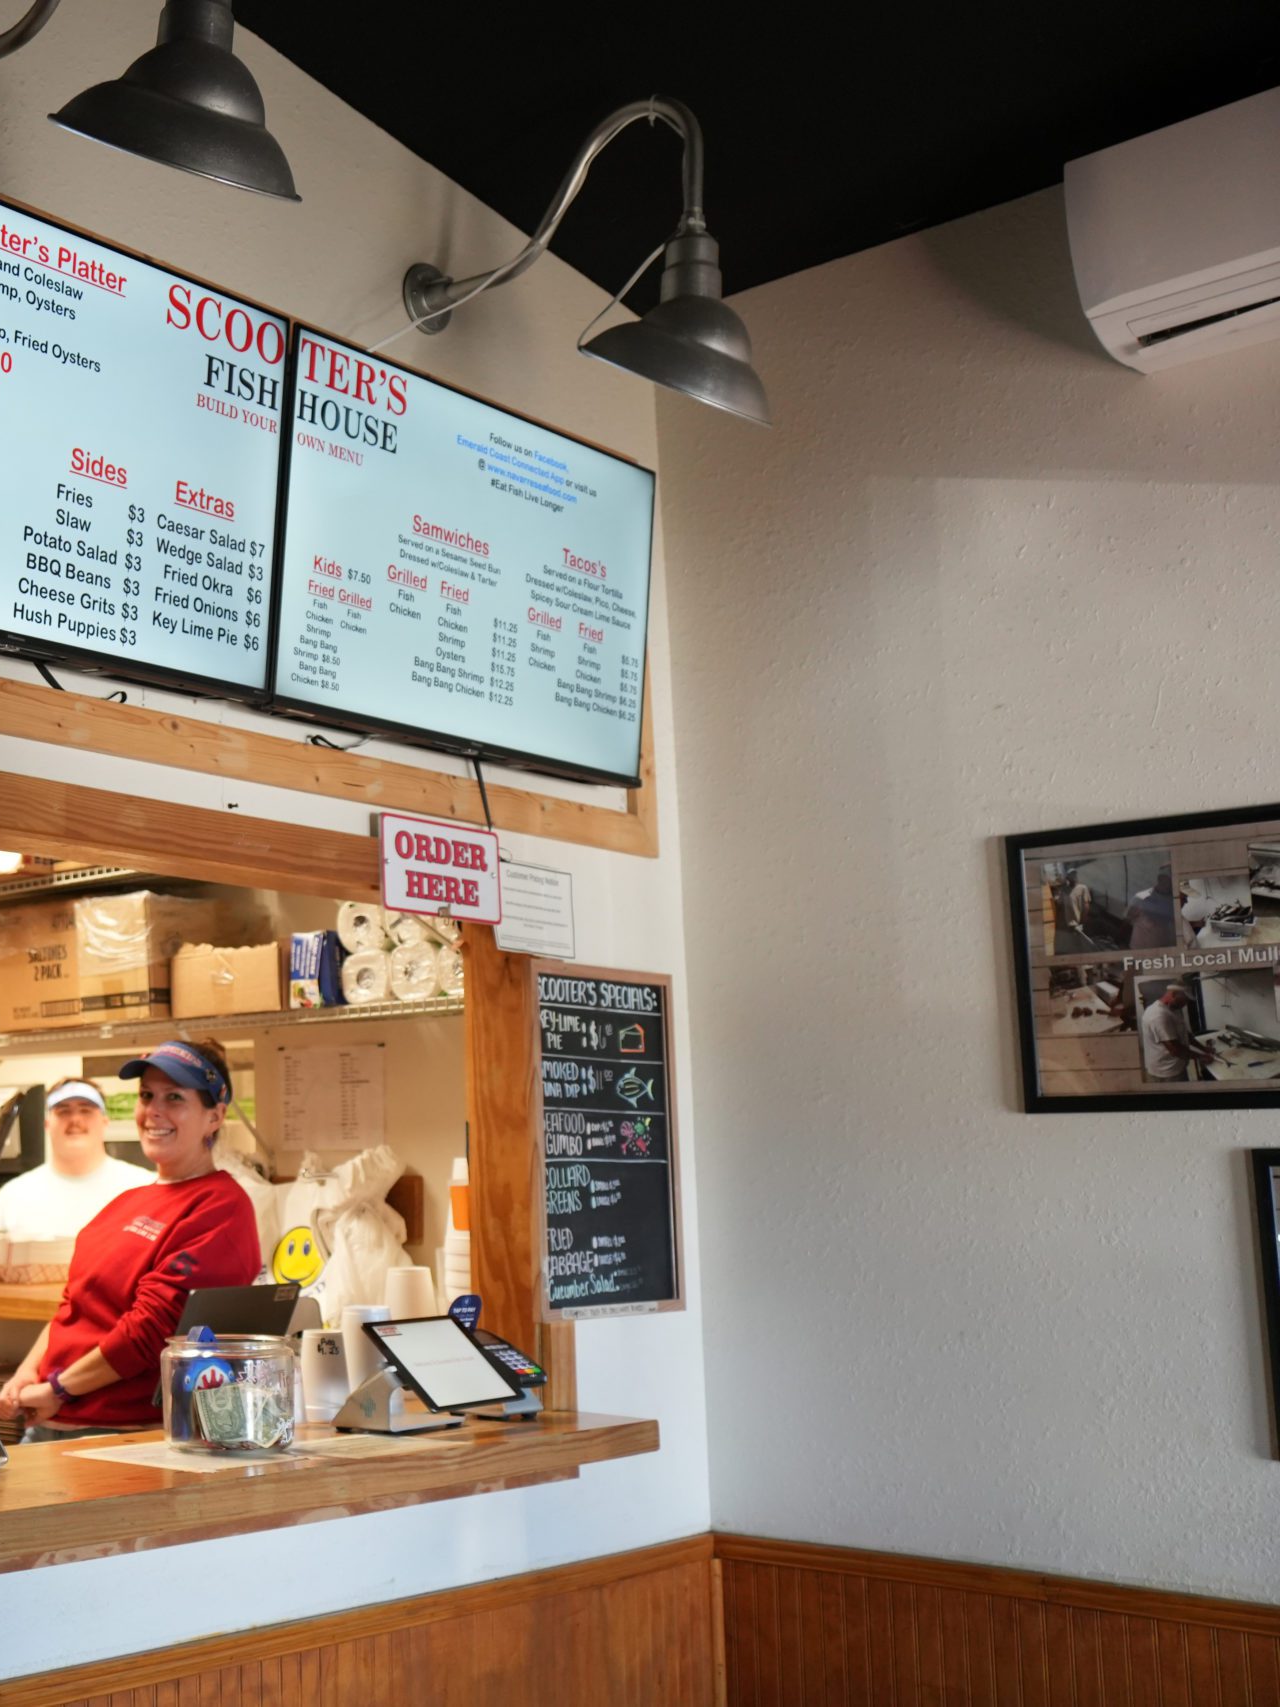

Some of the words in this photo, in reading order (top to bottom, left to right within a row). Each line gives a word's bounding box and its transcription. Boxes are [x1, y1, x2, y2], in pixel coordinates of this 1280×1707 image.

[23, 266, 83, 300] Coleslaw
[57, 246, 127, 292] Platter
[25, 289, 76, 320] Oysters
[13, 329, 48, 354] Fried
[51, 343, 100, 373] Oysters
[301, 338, 408, 416] TER'S
[203, 353, 279, 411] FISH
[296, 388, 397, 454] HOUSE
[196, 393, 238, 419] BUILD
[242, 409, 277, 434] YOUR
[297, 432, 326, 453] OWN
[327, 442, 364, 466] MENU
[71, 447, 127, 485] Sides
[175, 480, 234, 518] Extras
[23, 525, 72, 553] Potato
[76, 539, 117, 565] Salad
[124, 552, 141, 572] $3
[156, 513, 205, 540] Caesar
[209, 528, 246, 553] Salad
[249, 540, 265, 558] $7
[412, 514, 489, 555] Samwiches
[26, 552, 61, 578] BBQ
[65, 562, 111, 589] Beans
[122, 577, 140, 596] $3
[313, 555, 342, 577] Kids
[347, 568, 371, 584] $7.50
[562, 547, 606, 578] Tacos's
[387, 564, 427, 589] Grilled
[440, 580, 469, 602] Fried
[13, 601, 52, 626] Hush
[57, 612, 116, 641] Puppies
[119, 626, 136, 646] $3
[152, 610, 178, 634] Key
[181, 617, 213, 640] Lime
[217, 626, 238, 646] Pie
[243, 633, 259, 651] $6
[413, 655, 435, 673] Bang
[435, 661, 456, 678] Bang
[457, 667, 484, 684] Shrimp
[489, 675, 514, 692] $12.25
[435, 646, 465, 663] Oysters
[394, 830, 488, 872] ORDER
[405, 870, 480, 907] HERE
[1123, 954, 1175, 971] Fresh
[1180, 950, 1231, 967] Local
[542, 1061, 579, 1081] MOKED
[544, 1112, 585, 1134] EAFOOD
[546, 1133, 583, 1156] GUMBO
